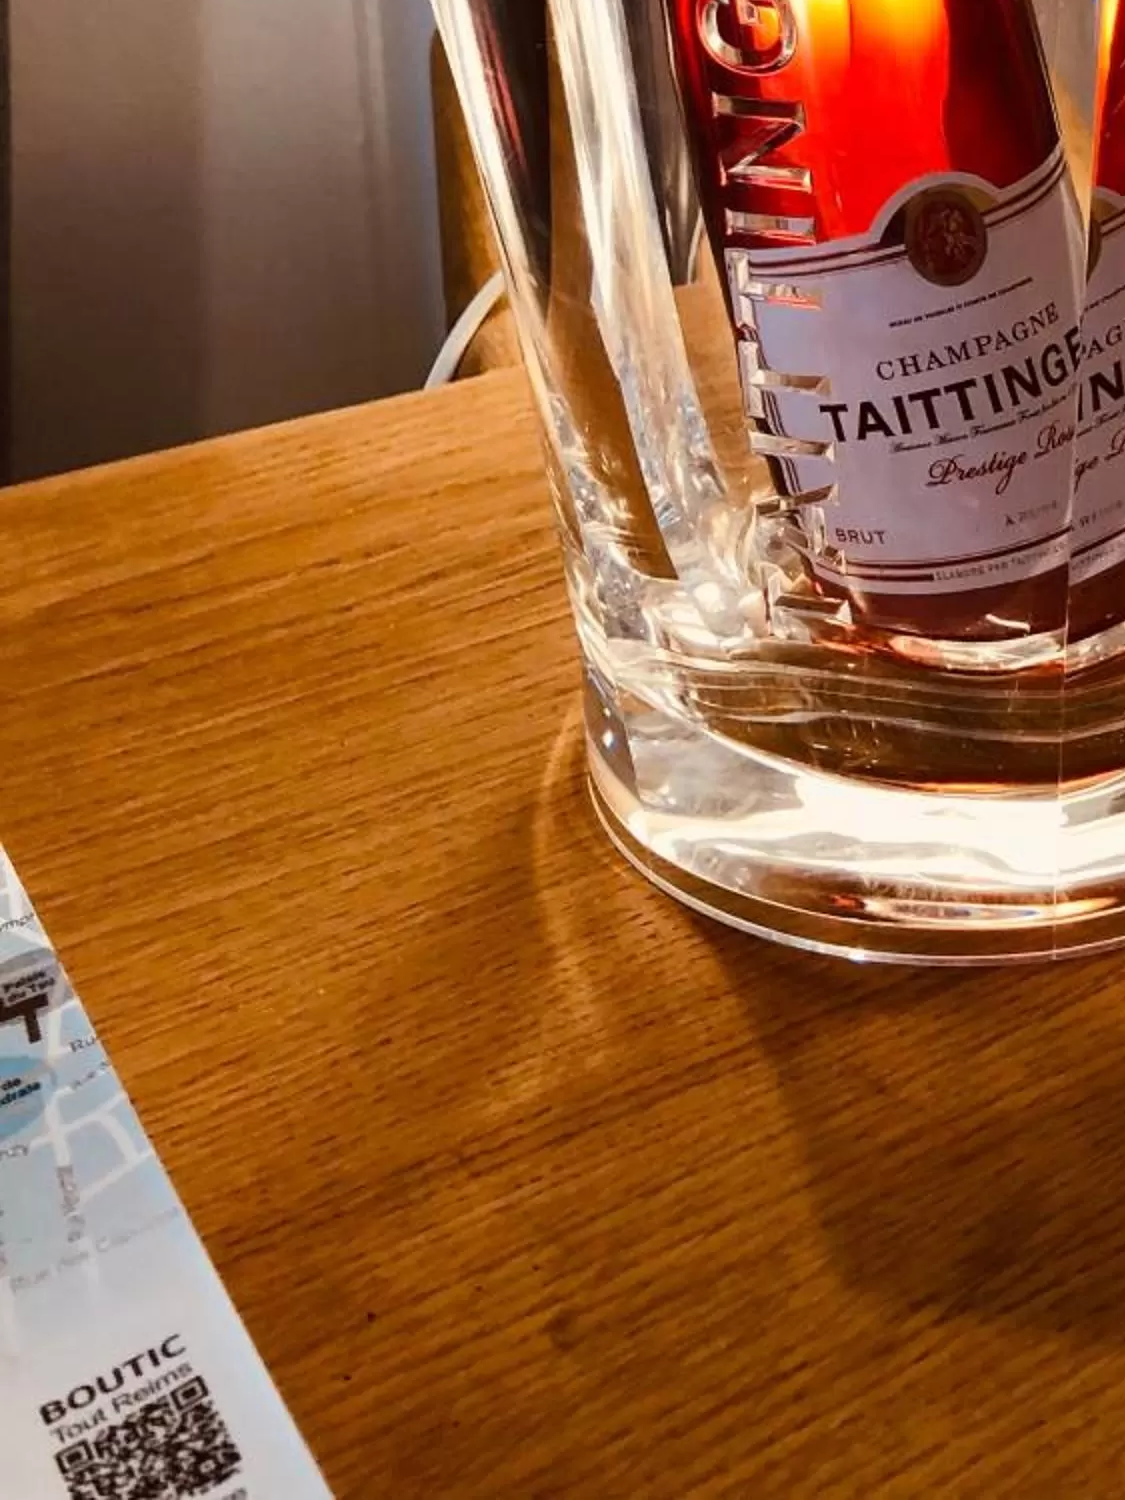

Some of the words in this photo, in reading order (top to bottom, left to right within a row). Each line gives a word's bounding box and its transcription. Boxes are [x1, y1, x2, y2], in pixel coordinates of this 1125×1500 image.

[876, 302, 1060, 381] CHAMPAGNE
[925, 453, 1028, 495] Prestige
[835, 527, 886, 545] BRUT
[39, 1333, 187, 1426] BOUTIC
[50, 1408, 108, 1445] Tout
[111, 1362, 194, 1413] Reims
